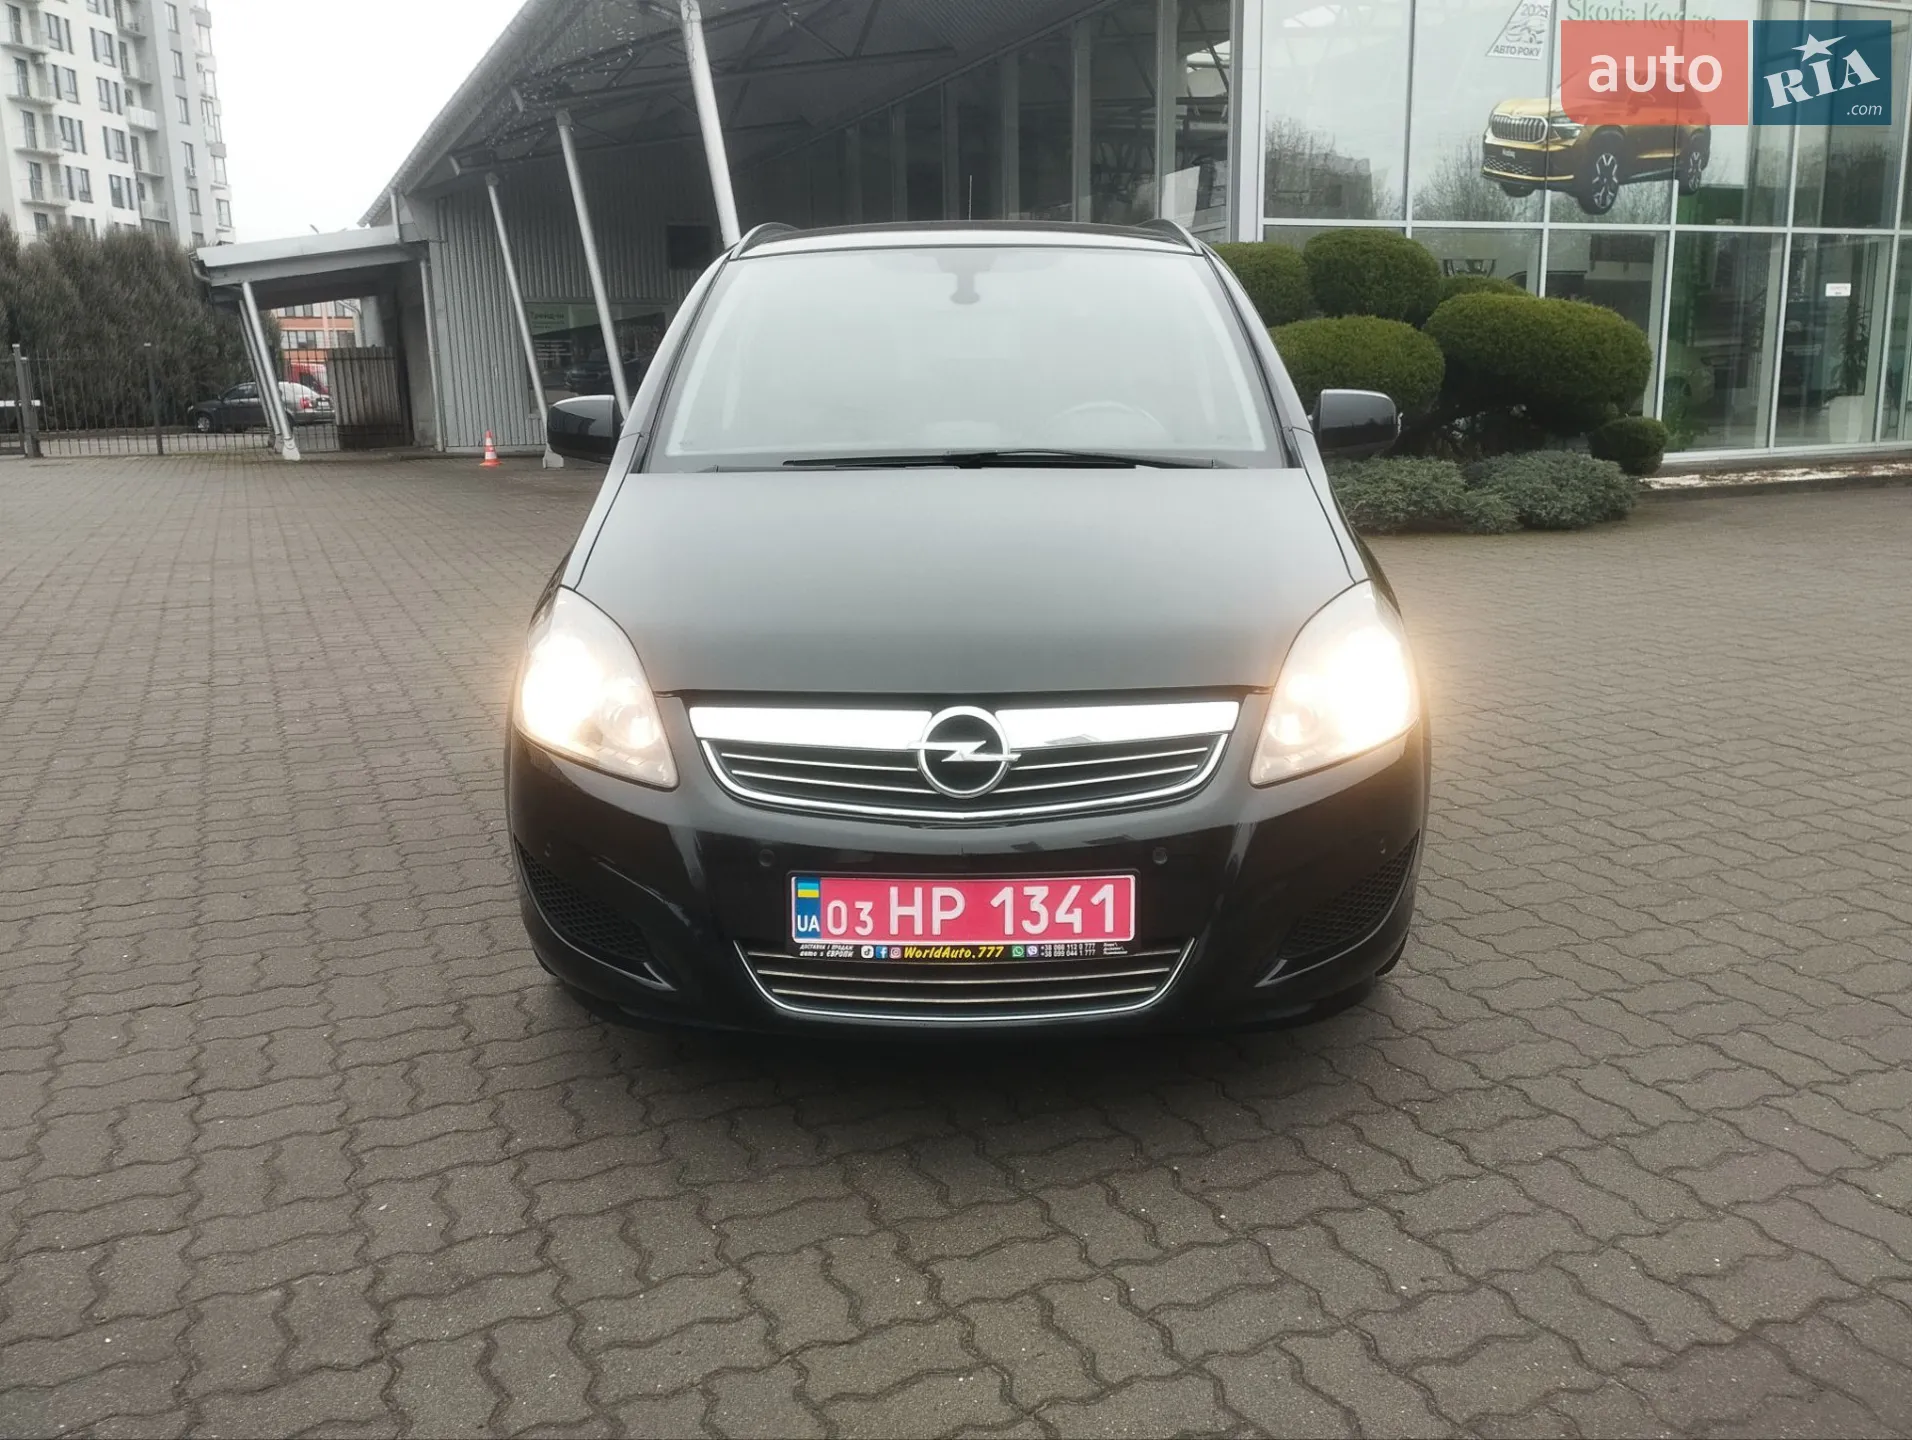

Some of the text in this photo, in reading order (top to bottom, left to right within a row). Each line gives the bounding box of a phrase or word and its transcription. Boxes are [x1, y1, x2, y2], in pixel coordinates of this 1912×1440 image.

[1521, 3, 1548, 18] 2025
[1493, 45, 1516, 55] АВТО
[827, 884, 1115, 936] 03 HP 1341
[797, 915, 820, 932] UA
[903, 945, 1005, 959] WorldAuto.777
